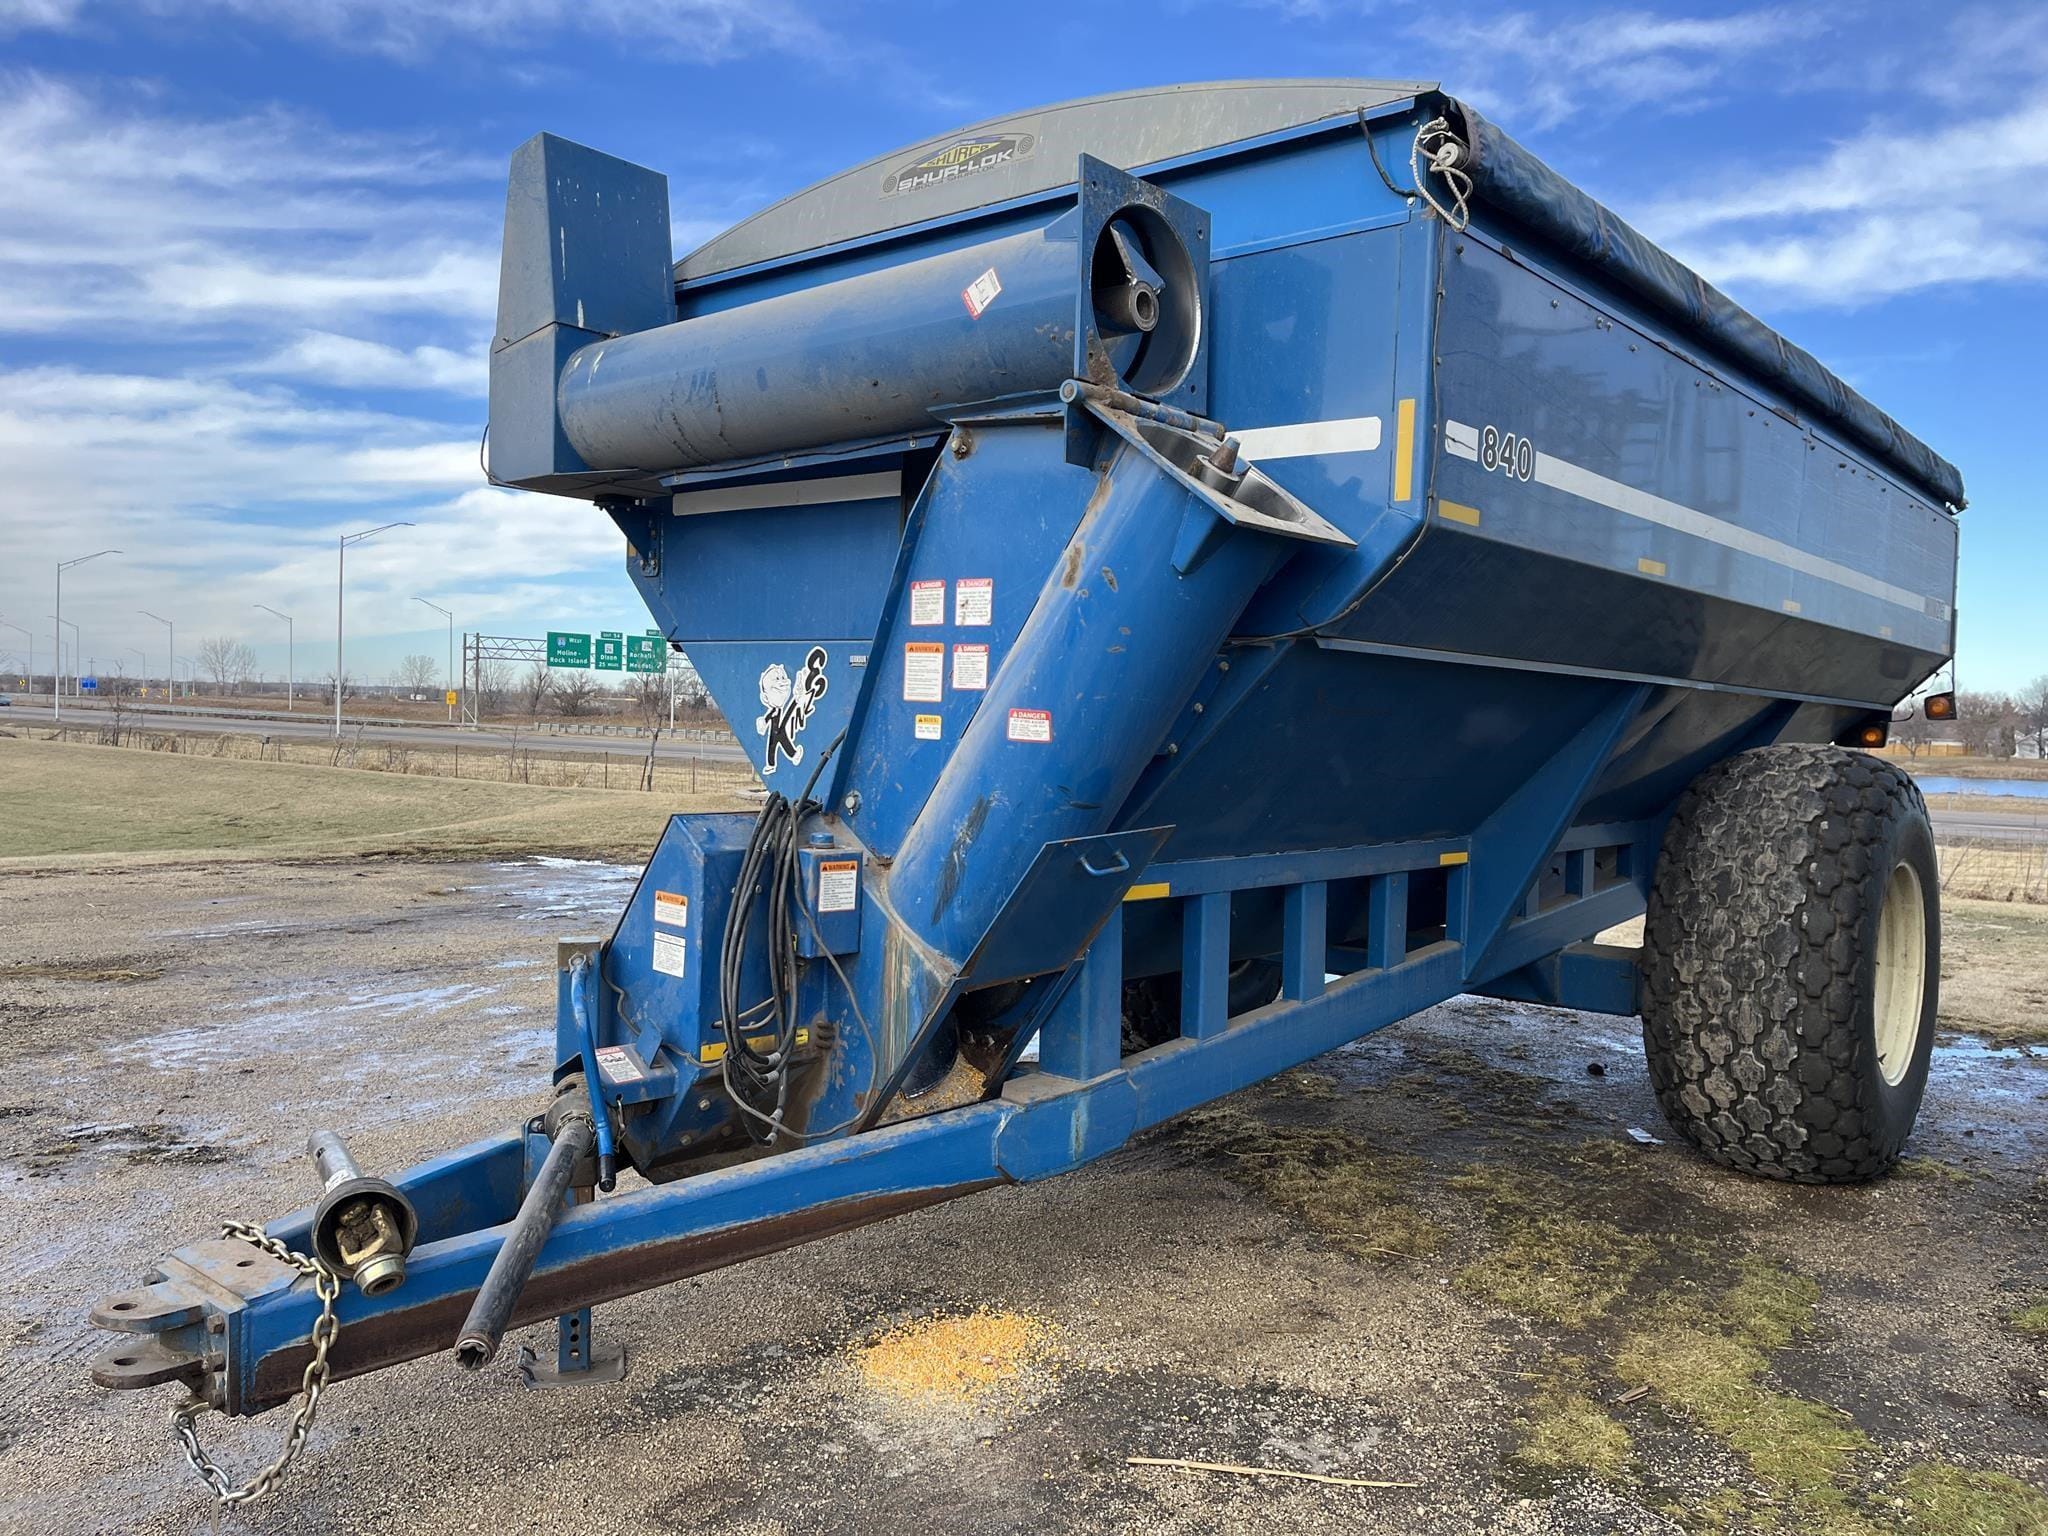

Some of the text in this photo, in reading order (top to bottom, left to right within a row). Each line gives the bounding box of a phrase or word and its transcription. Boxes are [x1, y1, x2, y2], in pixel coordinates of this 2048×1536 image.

[898, 149, 1014, 190] SHUR-LOK
[1482, 425, 1532, 482] 840
[1018, 711, 1046, 719] DANGER
